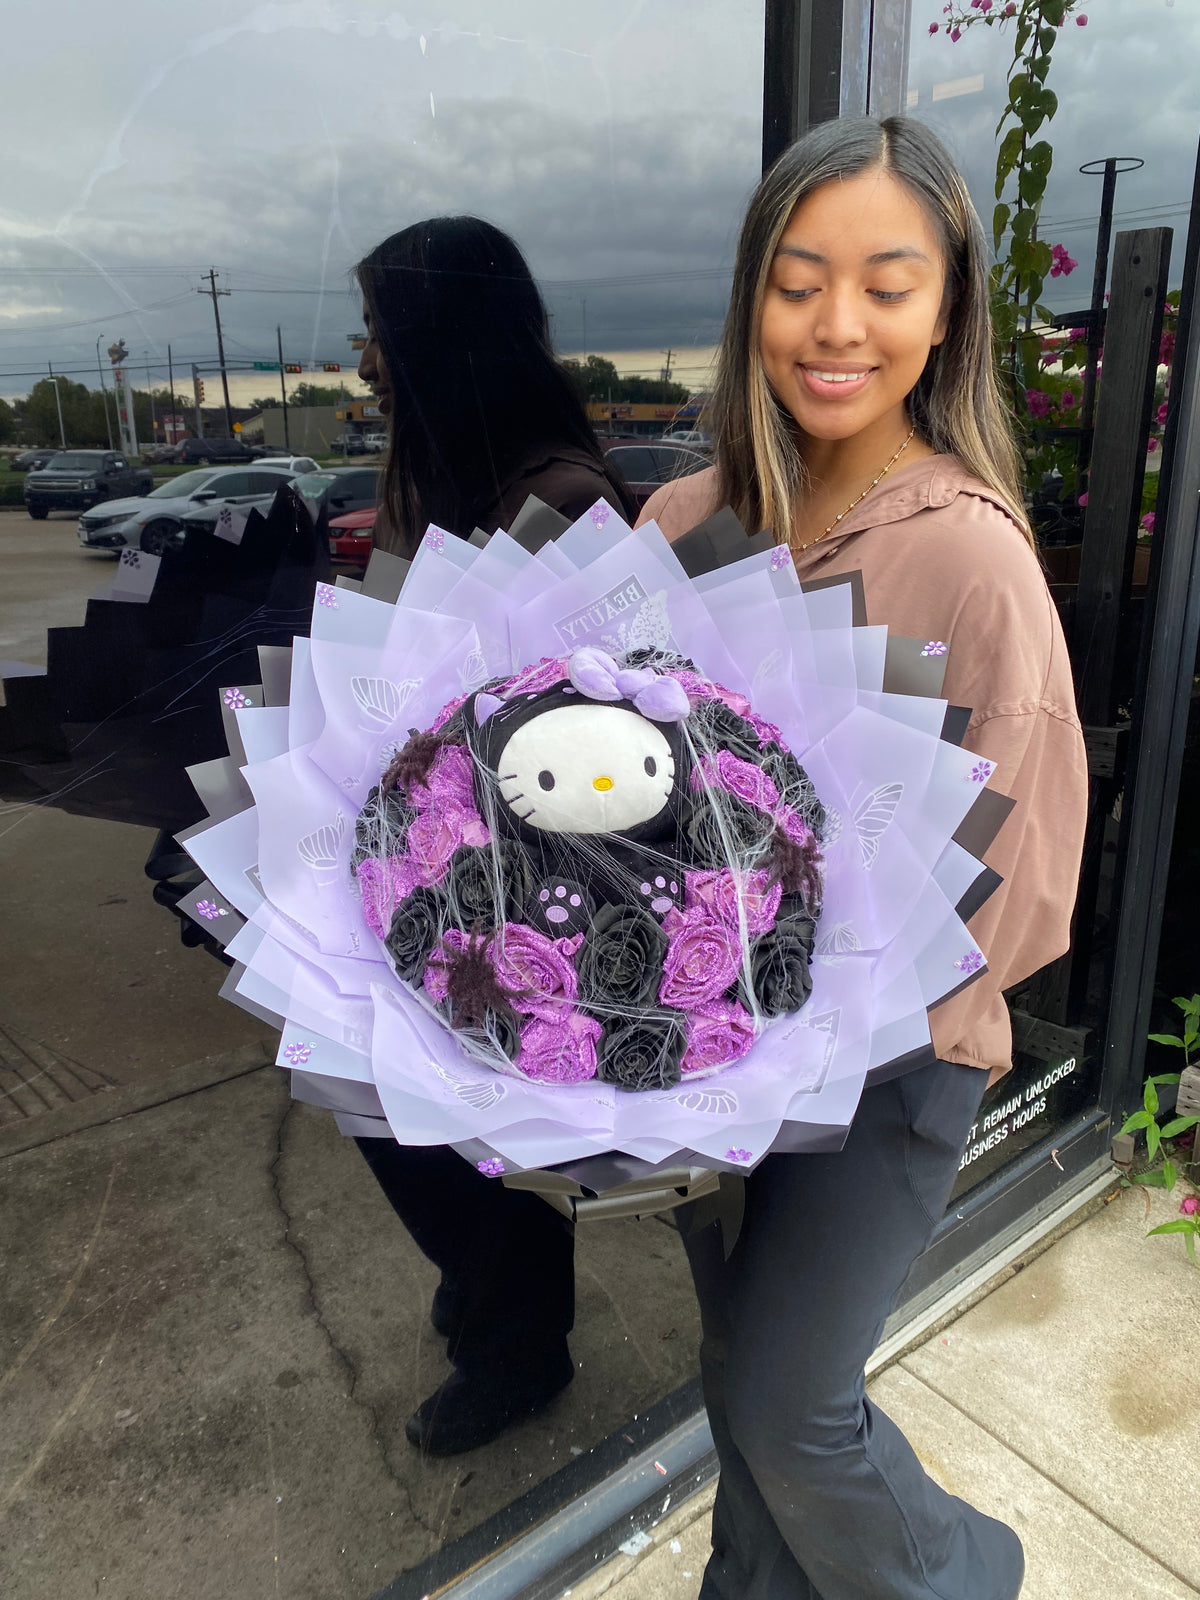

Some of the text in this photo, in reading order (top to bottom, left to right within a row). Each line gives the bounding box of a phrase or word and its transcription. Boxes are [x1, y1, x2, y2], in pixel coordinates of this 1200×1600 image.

[983, 1093, 1022, 1132] REMAIN
[1026, 1057, 1076, 1102] UNLOCKED
[1012, 1096, 1047, 1132] HOURS
